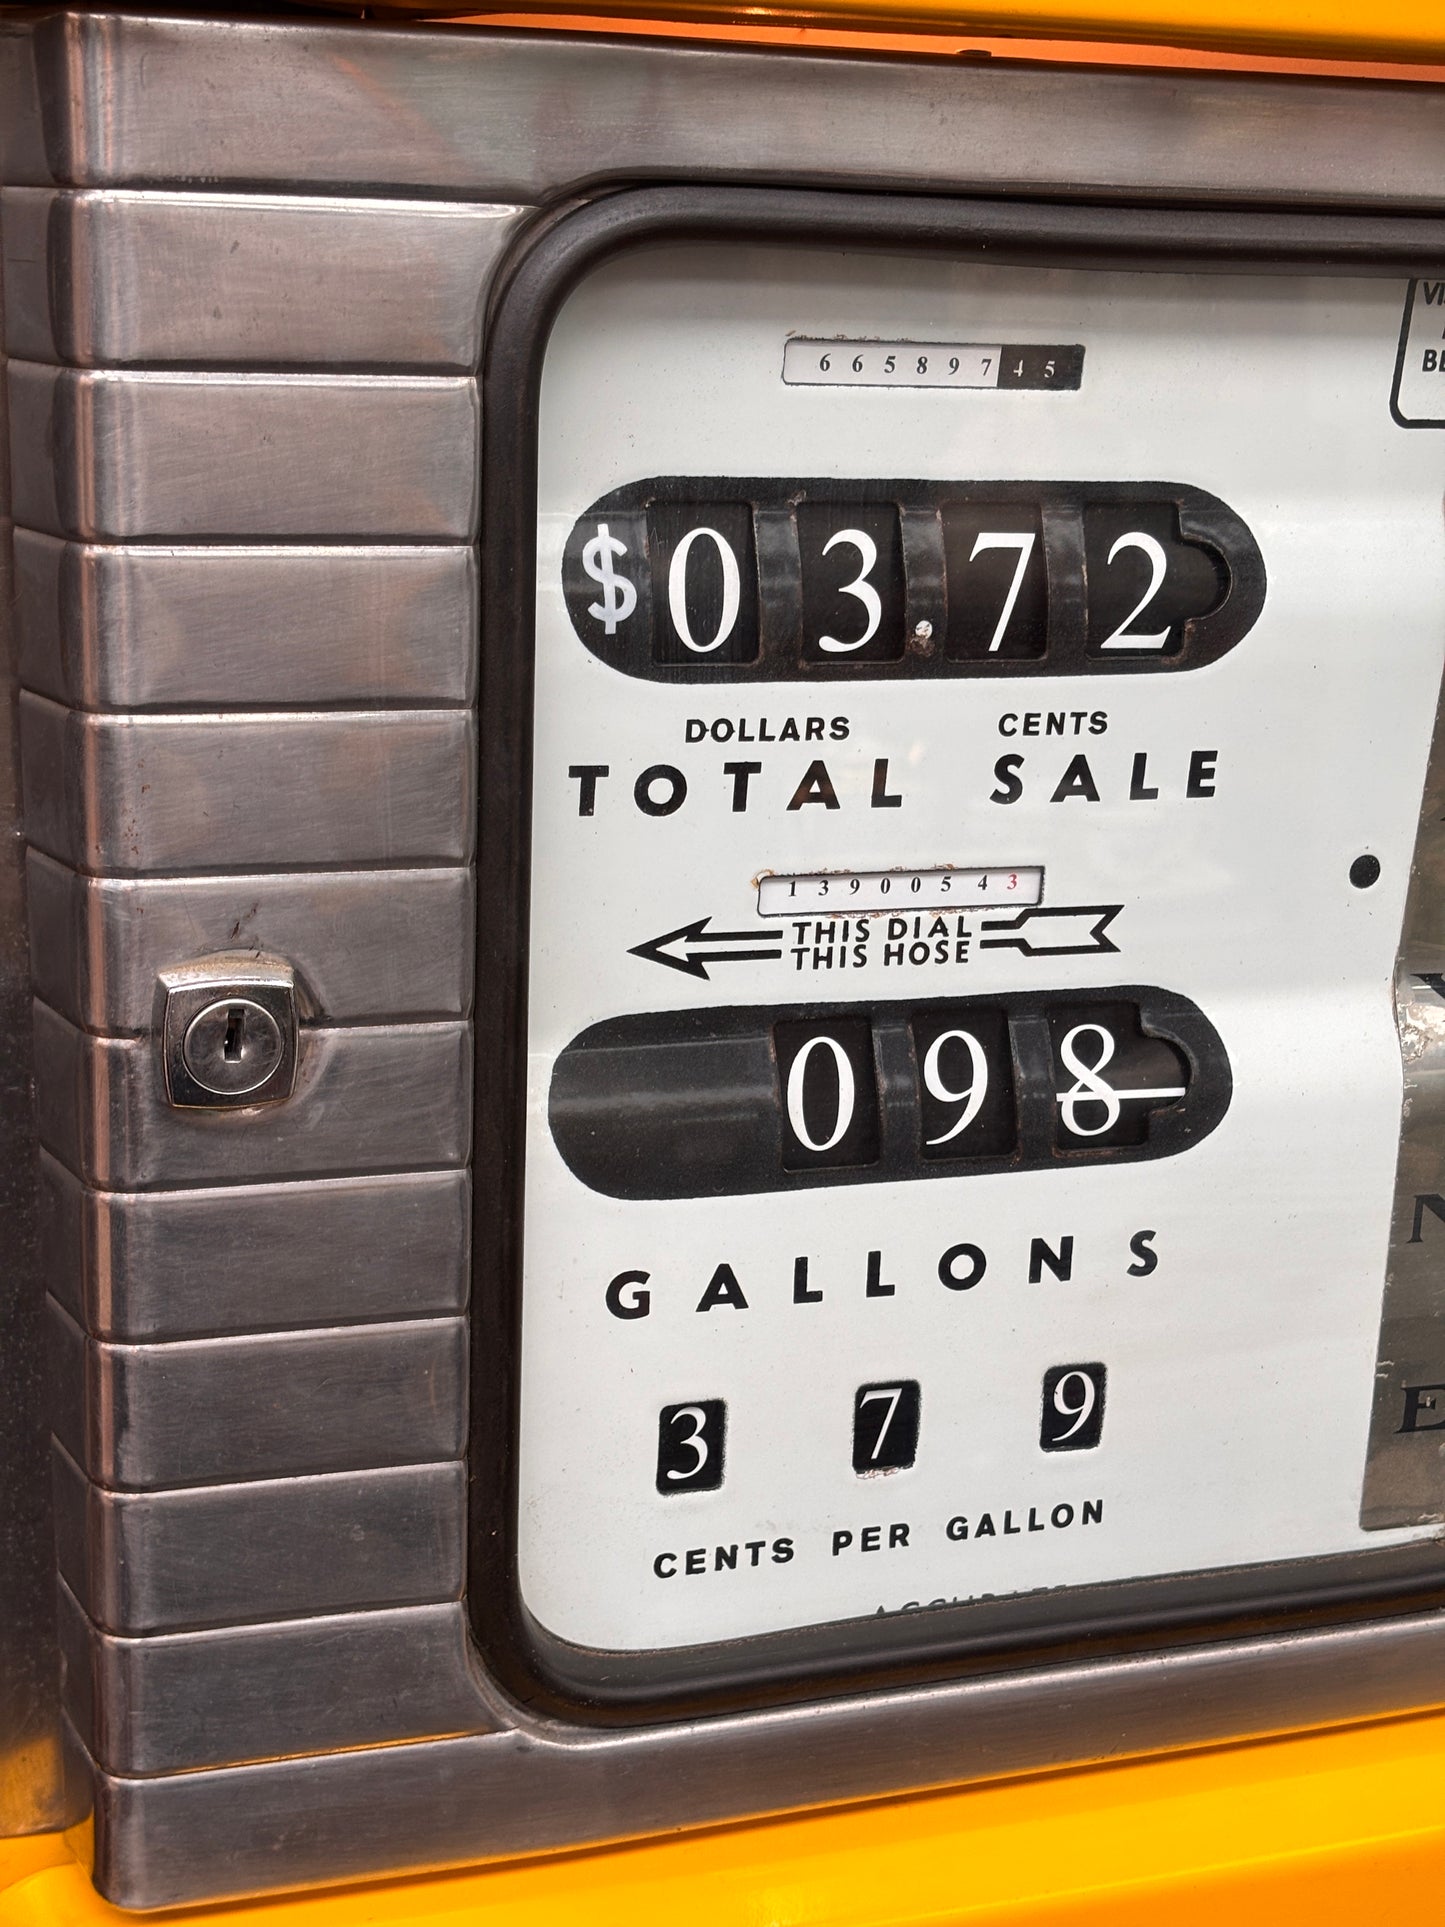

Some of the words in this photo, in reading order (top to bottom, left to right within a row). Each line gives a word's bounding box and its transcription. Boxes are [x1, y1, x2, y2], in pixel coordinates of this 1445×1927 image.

[686, 716, 850, 744] DOLLARS
[998, 710, 1108, 738] CENTS
[568, 758, 903, 817] TOTAL
[989, 750, 1219, 805] SALE
[791, 943, 868, 970] THIS
[884, 940, 970, 968] HOSE
[792, 919, 870, 945] THIS
[888, 916, 972, 941] DIAL
[605, 1229, 1159, 1320] GALLONS
[653, 1537, 795, 1579] CENTS
[832, 1523, 910, 1557] PER
[945, 1499, 1103, 1542] GALLON
